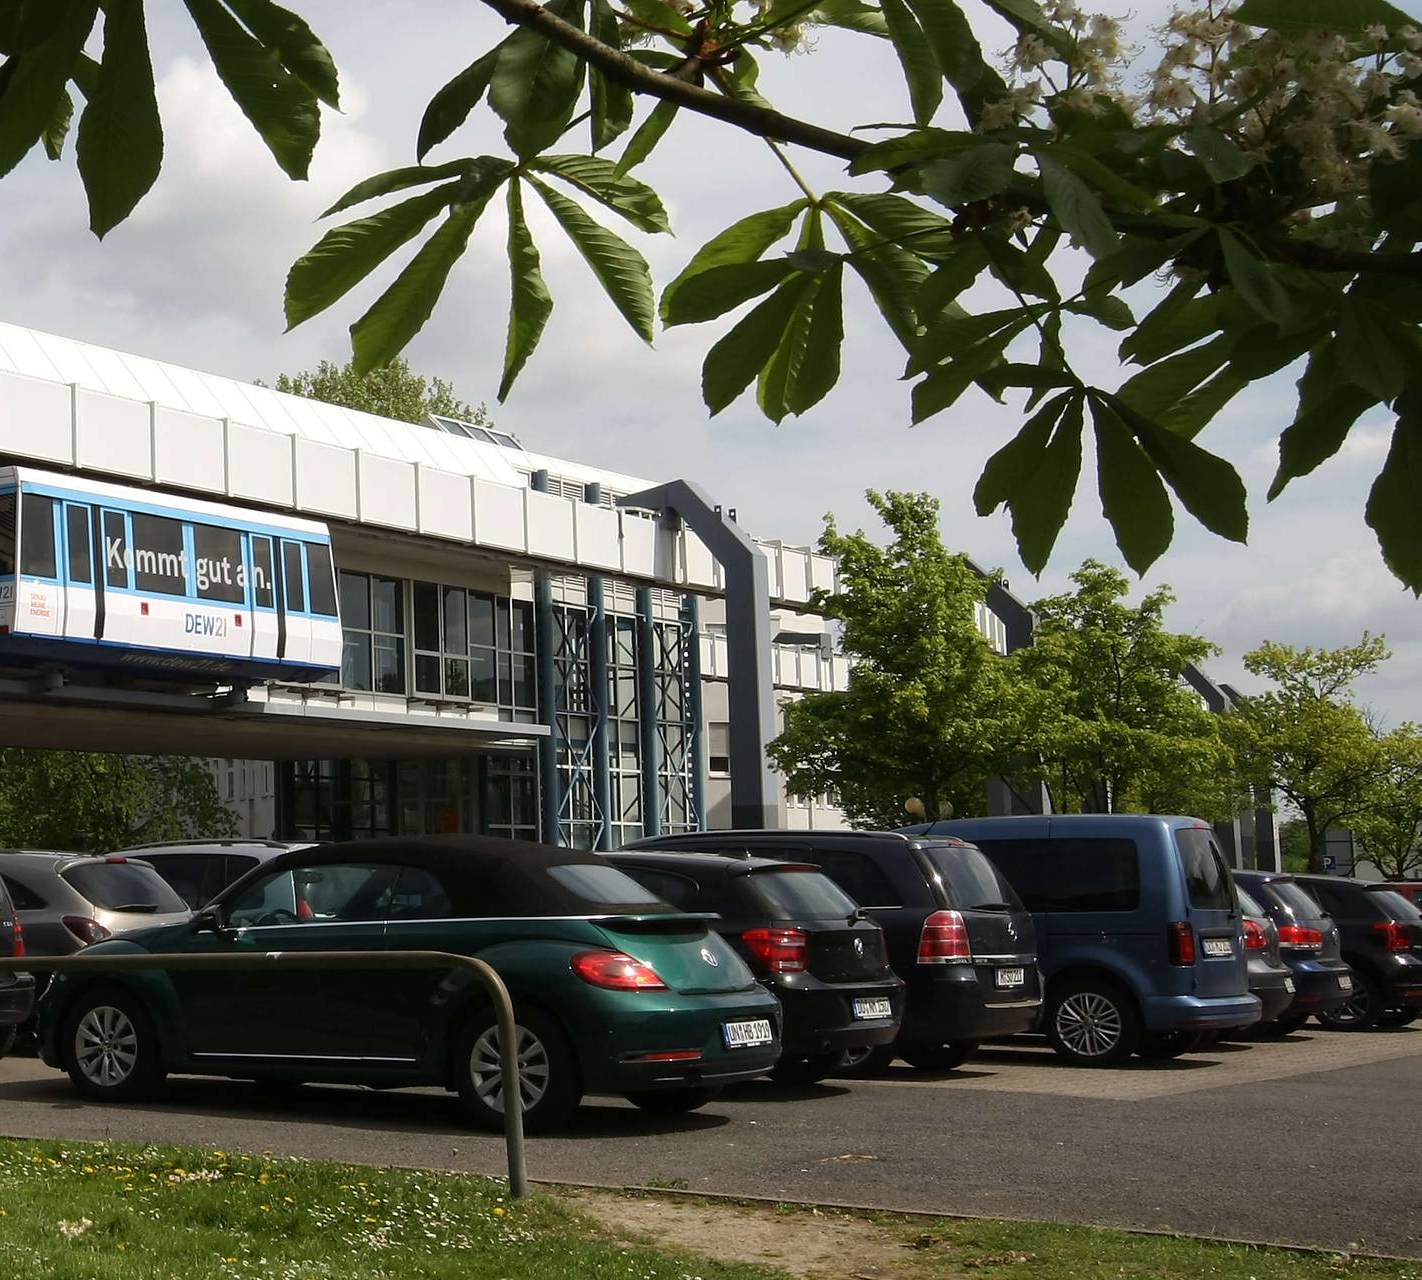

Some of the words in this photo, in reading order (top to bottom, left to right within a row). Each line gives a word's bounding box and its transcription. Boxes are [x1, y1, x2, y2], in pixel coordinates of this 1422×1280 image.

[106, 536, 187, 578] Kommt
[196, 556, 232, 590] gut
[236, 562, 272, 590] an.
[185, 613, 227, 637] DEW21
